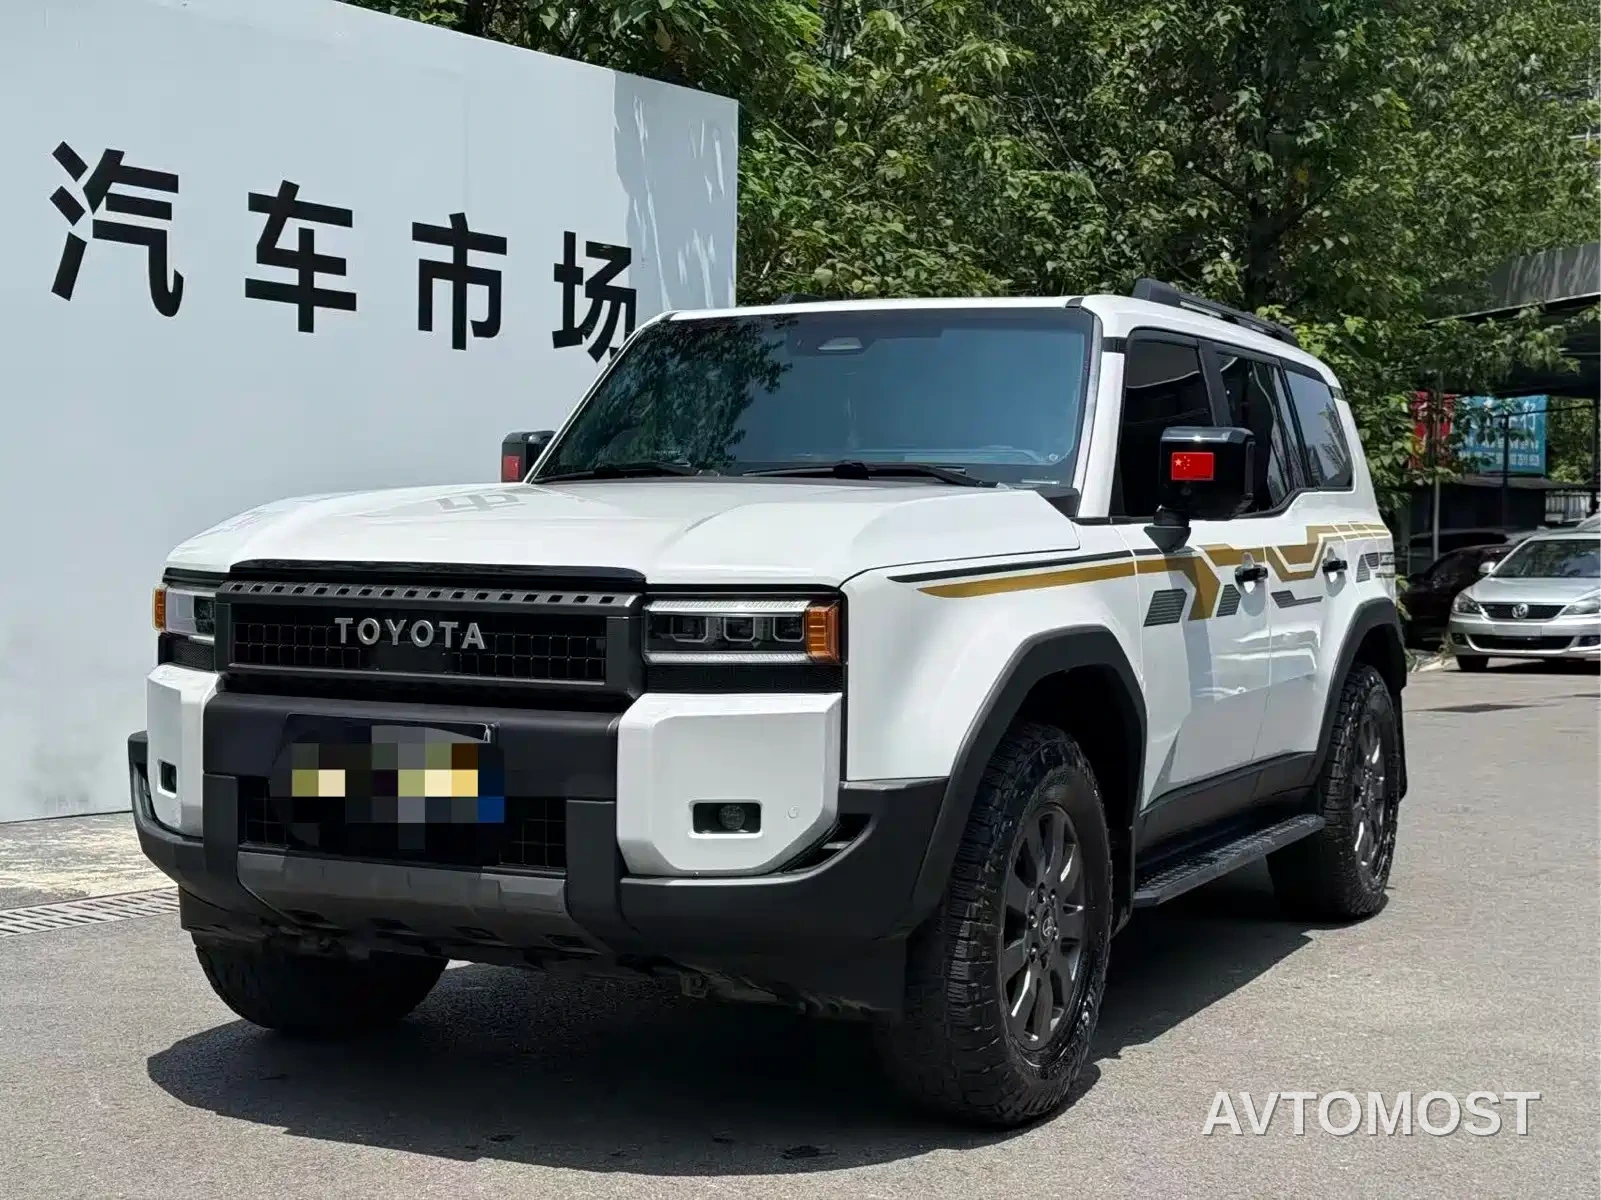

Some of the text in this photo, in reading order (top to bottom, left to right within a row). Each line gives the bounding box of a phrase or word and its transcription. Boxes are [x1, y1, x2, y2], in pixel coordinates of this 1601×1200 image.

[50, 140, 637, 363] 汽车市场
[334, 617, 487, 649] TOYOTA
